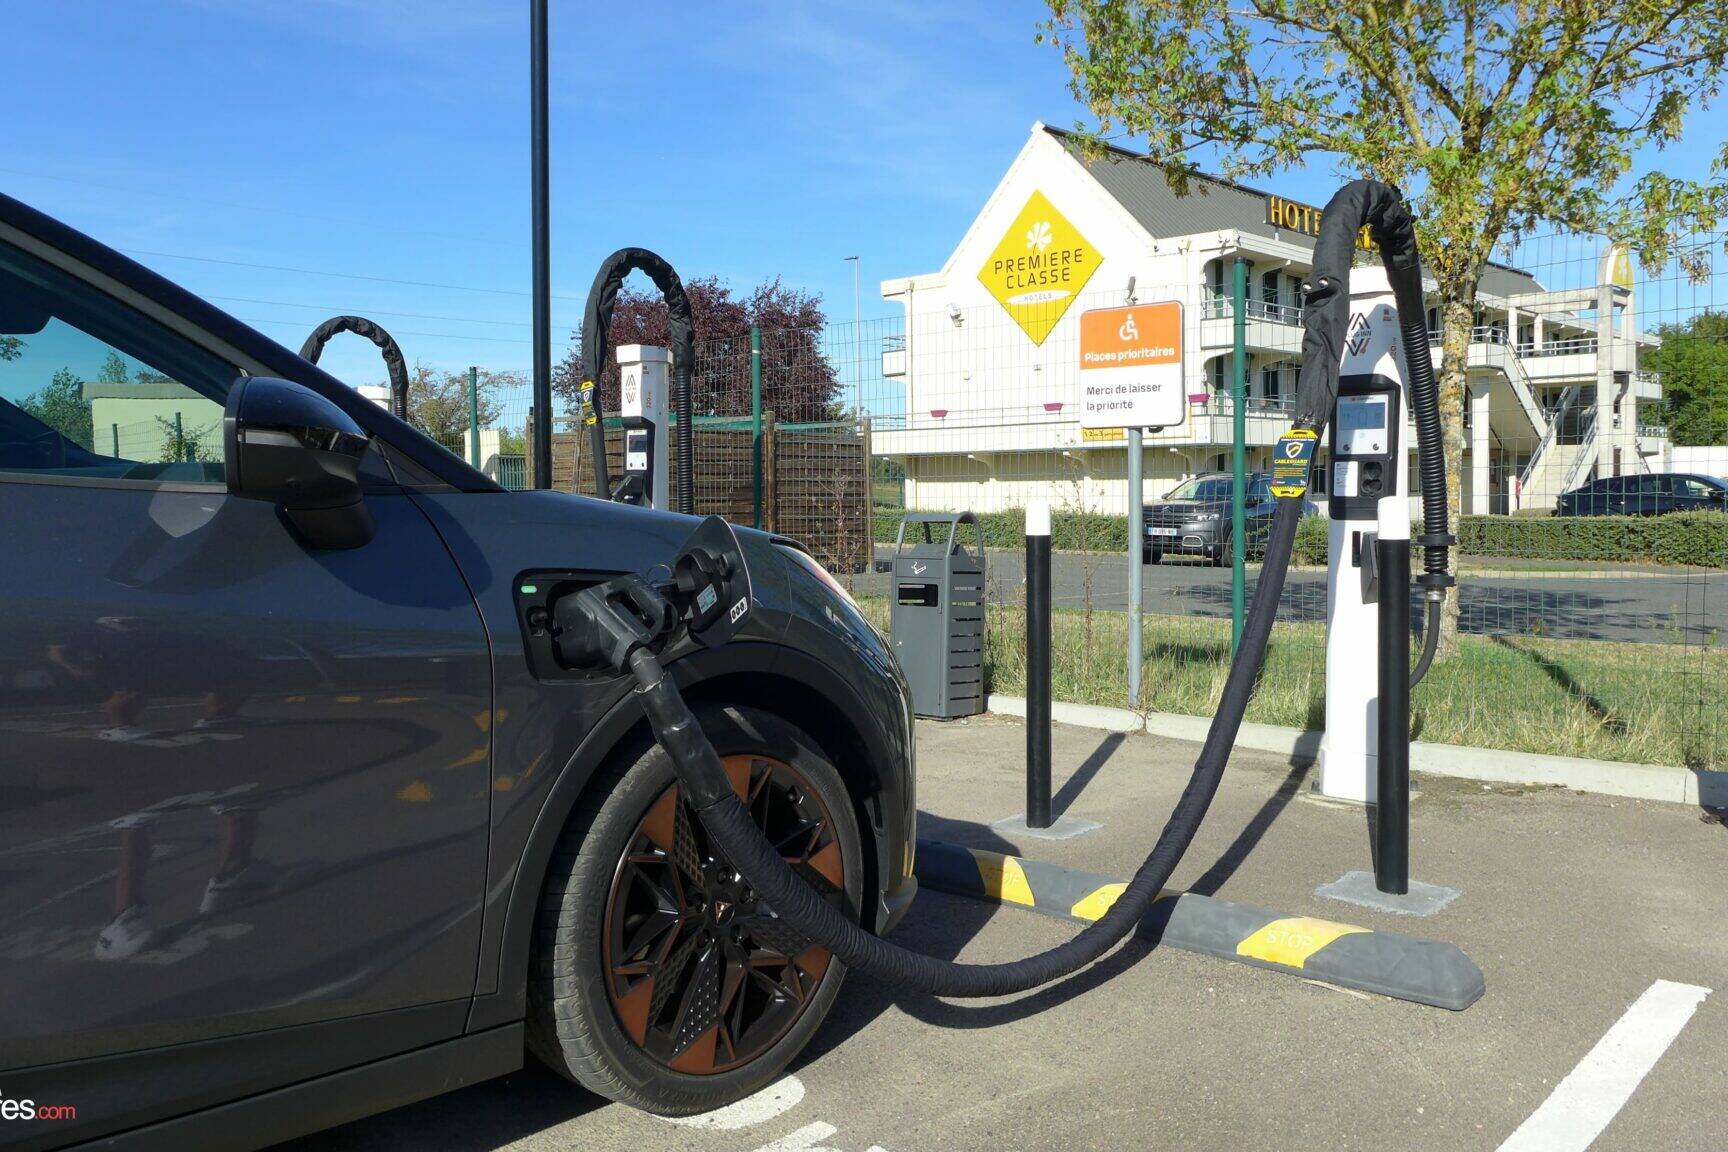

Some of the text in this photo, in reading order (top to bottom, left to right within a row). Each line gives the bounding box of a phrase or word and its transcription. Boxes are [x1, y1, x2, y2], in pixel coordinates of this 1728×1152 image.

[1270, 195, 1323, 236] HOTE
[994, 248, 1083, 275] PREMIERE
[1006, 267, 1070, 289] CLASSE
[1084, 347, 1175, 362] Places prioritaires
[1086, 383, 1162, 396] Merci de laisser
[1086, 400, 1133, 412] la priorité
[1266, 929, 1313, 950] STOP
